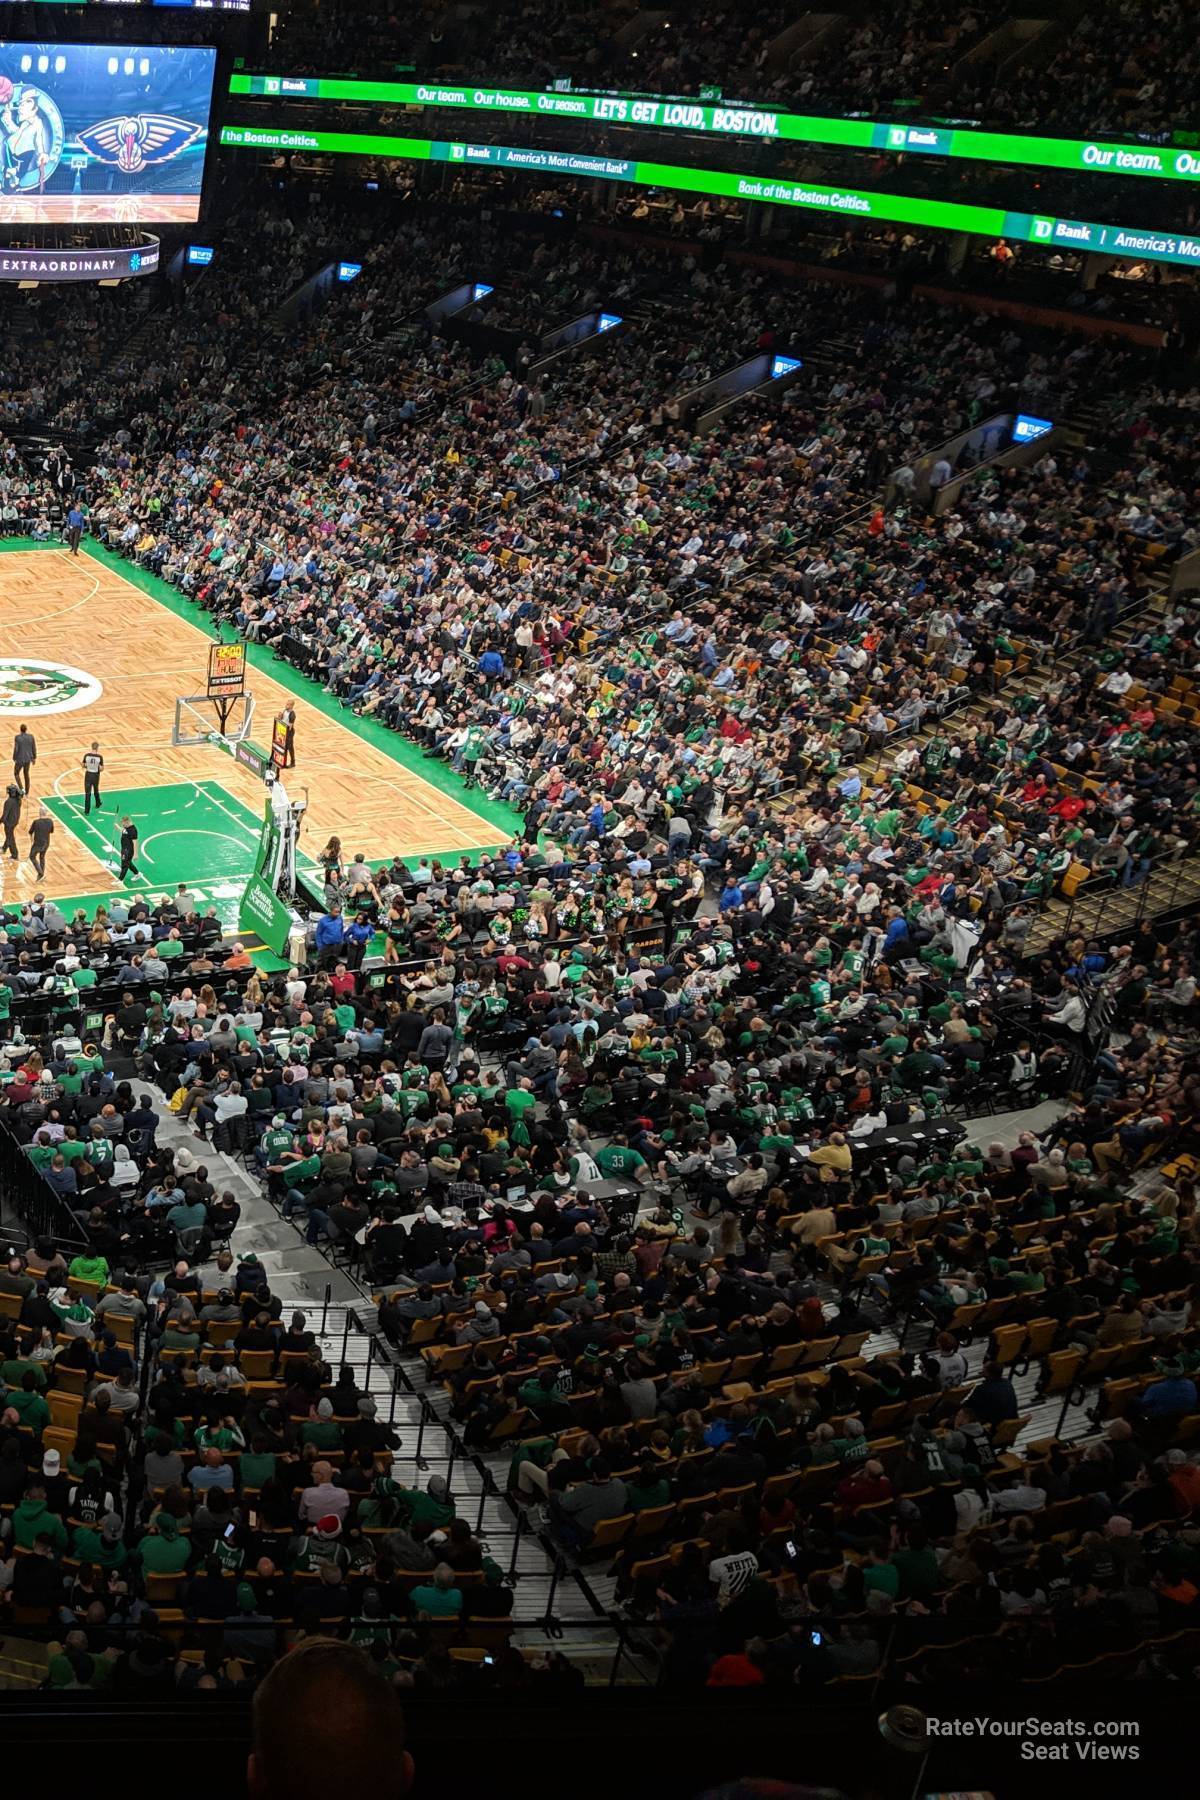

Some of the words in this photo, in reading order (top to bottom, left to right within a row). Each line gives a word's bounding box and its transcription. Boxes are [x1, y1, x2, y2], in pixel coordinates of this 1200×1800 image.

[282, 80, 306, 91] Bank
[418, 87, 437, 100] Our
[438, 89, 467, 102] team.
[474, 91, 494, 105] Our
[495, 92, 531, 107] house.
[538, 96, 555, 110] Our
[555, 98, 587, 112] season.
[593, 98, 627, 120] LET'S
[631, 102, 659, 122] GET
[663, 105, 706, 130] LOUD,
[712, 109, 779, 135] BOSTON.
[226, 131, 242, 142] the
[244, 132, 279, 145] Boston
[280, 134, 319, 147] Celtics.
[908, 131, 938, 144] Bank
[467, 147, 490, 159] Bank
[507, 151, 547, 165] America's
[548, 155, 568, 167] Most
[569, 158, 605, 172] Convenient
[1083, 146, 1114, 165] Our
[1115, 149, 1162, 171] team.
[738, 181, 762, 195] Bank
[764, 183, 775, 197] of
[775, 186, 791, 200] the
[792, 188, 829, 205] Boston
[830, 193, 872, 211] Celtics.
[1055, 223, 1091, 241] Bank
[1114, 232, 1176, 253] America's
[2, 259, 116, 271] EXTRAORDINARY
[221, 676, 243, 684] TISSOT
[635, 938, 663, 948] GARDEN
[88, 1017, 101, 1028] TD
[98, 1152, 106, 1161] 7
[611, 1155, 624, 1168] 33
[589, 1165, 599, 1180] 11
[79, 1498, 100, 1510] TATUM
